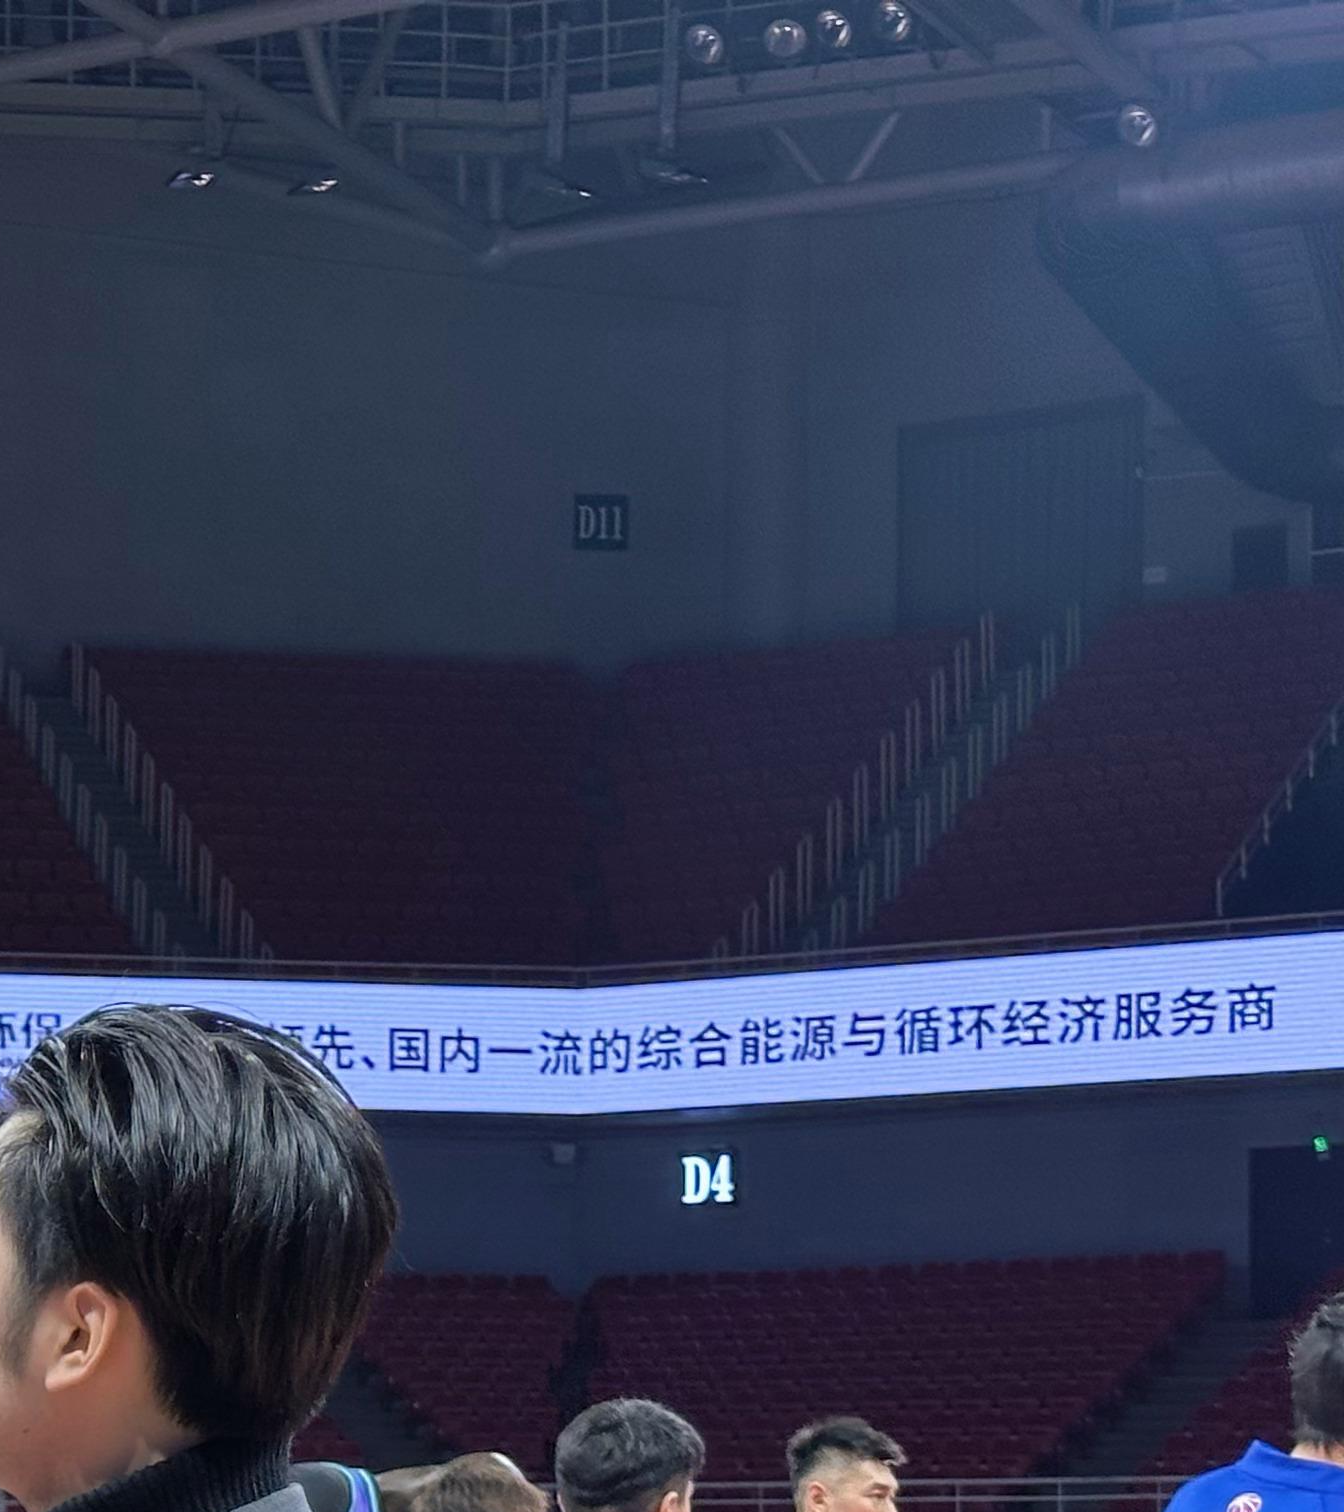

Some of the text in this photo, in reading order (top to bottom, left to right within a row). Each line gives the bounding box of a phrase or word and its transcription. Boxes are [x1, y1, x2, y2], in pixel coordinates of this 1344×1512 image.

[578, 503, 624, 541] D11
[270, 983, 1277, 1077] 先、国内一流的综合能源与循环经济服务商
[681, 1154, 736, 1204] D4
